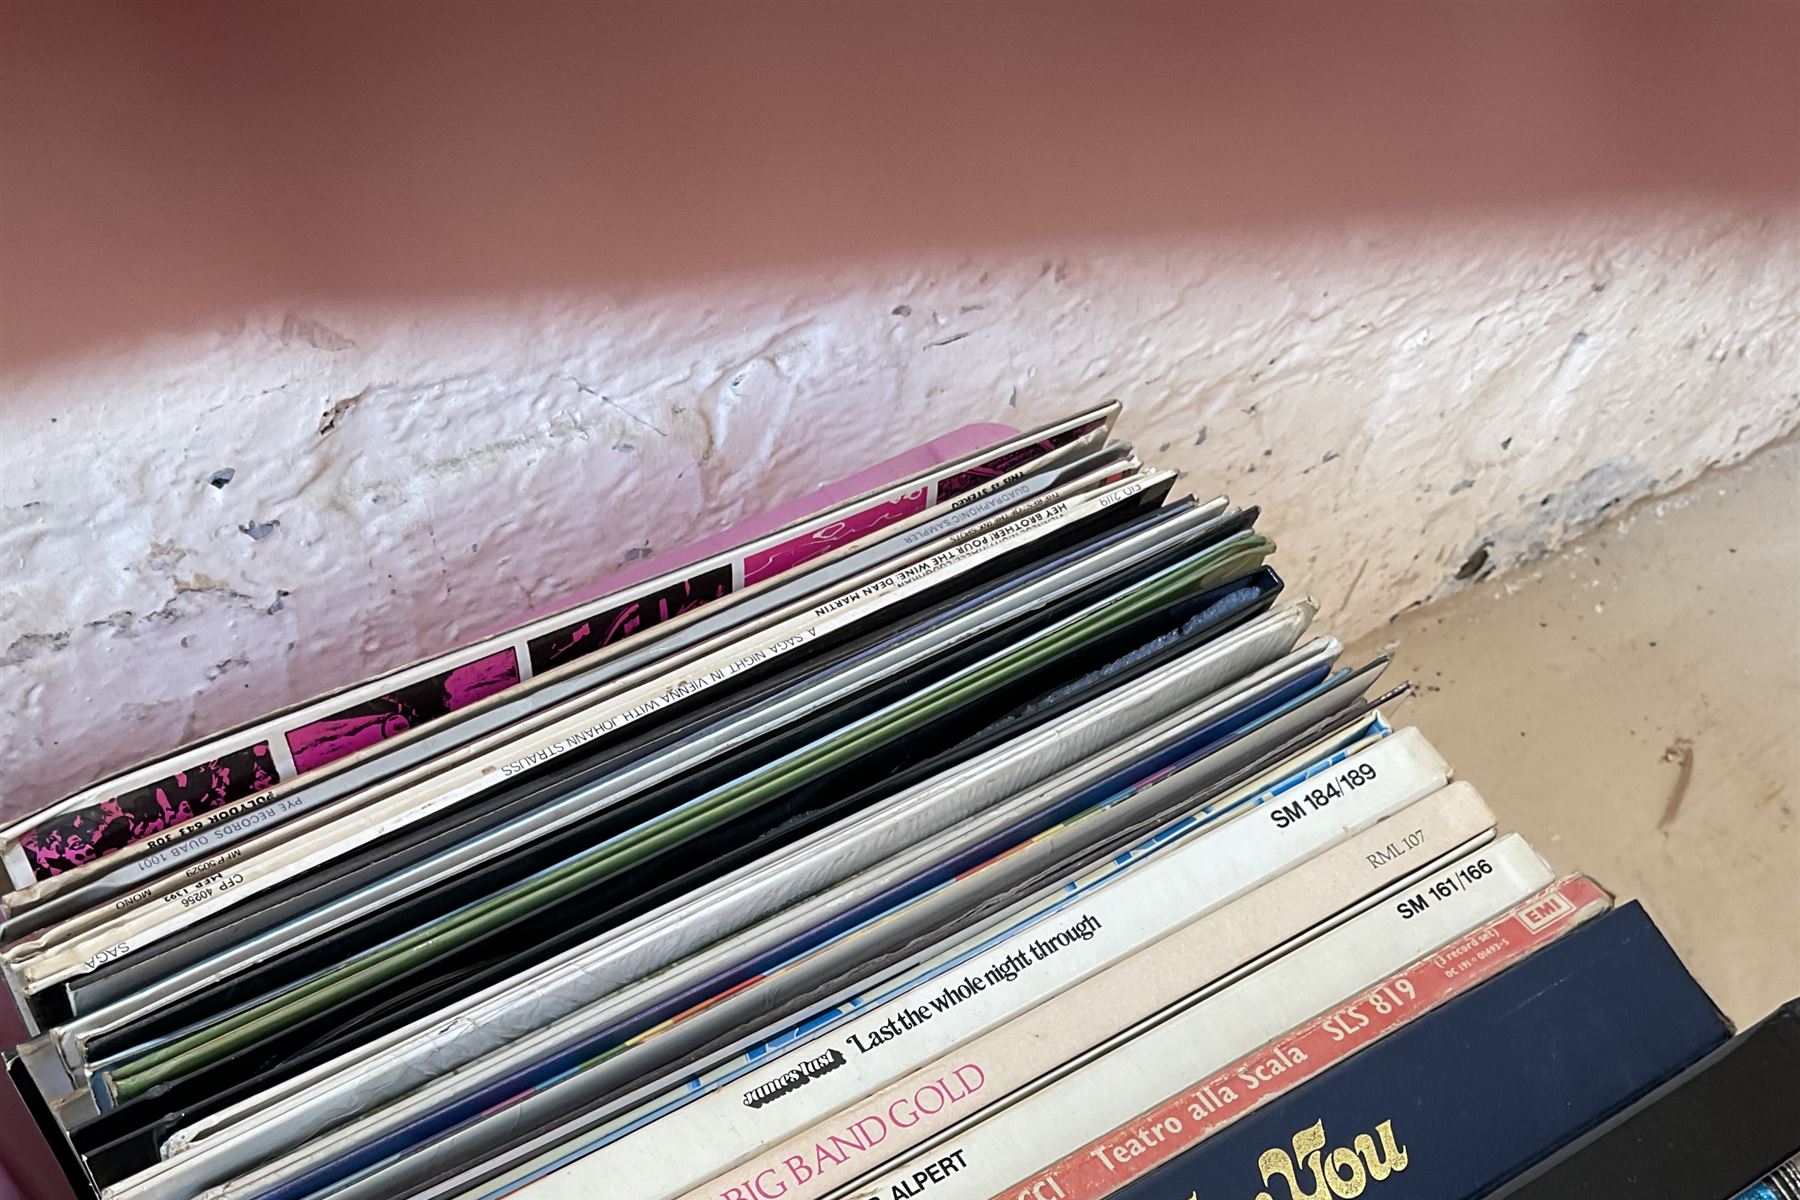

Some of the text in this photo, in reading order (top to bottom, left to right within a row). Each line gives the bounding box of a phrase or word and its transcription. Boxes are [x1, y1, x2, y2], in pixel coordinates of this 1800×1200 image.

[904, 485, 1030, 544] QUADRAPHONIC SAMPLER
[949, 527, 977, 544] SPOTS
[815, 503, 1068, 616] HEY BROTHER! POUR THE WINE: DEAN MARTIN
[501, 627, 816, 777] A SAGA NIGHT IN VIENNA WITH JOHANN STRAUSS
[147, 791, 276, 850] POLYDOR 643 308
[1270, 762, 1377, 829] SM 184/189
[138, 797, 303, 872] PYE RECORDS QUAB 1001
[1365, 828, 1426, 870] RML 107
[115, 889, 152, 910] MONO
[181, 873, 243, 907] CFP 40256
[1396, 858, 1494, 920] SM 161/166
[1524, 897, 1564, 925] EMI
[85, 942, 130, 969] SAGA
[1446, 938, 1477, 963] record
[846, 913, 1102, 1054] Last the whole night through
[1090, 1115, 1183, 1174] Teatro
[1186, 1083, 1239, 1122] alla
[1242, 1042, 1309, 1091] Scala
[1322, 1007, 1371, 1043] SLS
[1367, 977, 1418, 1018] 819
[782, 1115, 889, 1187] BAND
[887, 1063, 987, 1129] GOLD
